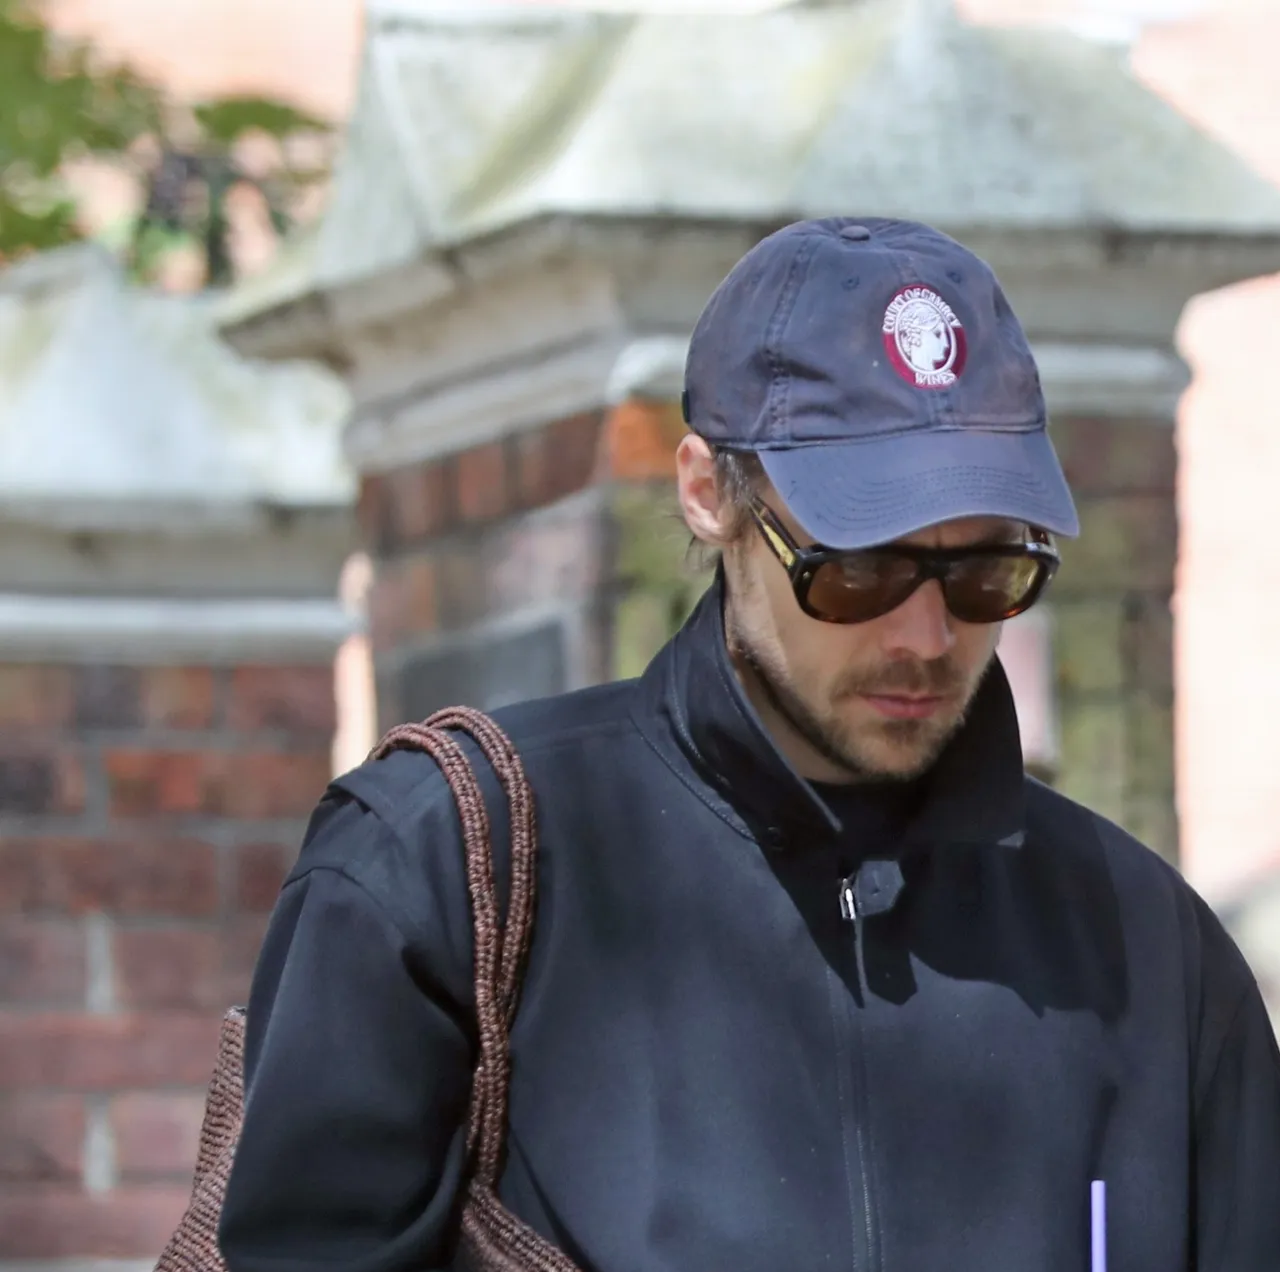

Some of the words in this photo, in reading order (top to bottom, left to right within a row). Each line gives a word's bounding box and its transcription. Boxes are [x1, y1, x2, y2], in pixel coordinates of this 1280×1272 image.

[882, 293, 908, 332] COURT
[904, 287, 922, 300] OF
[915, 369, 957, 385] WINES
